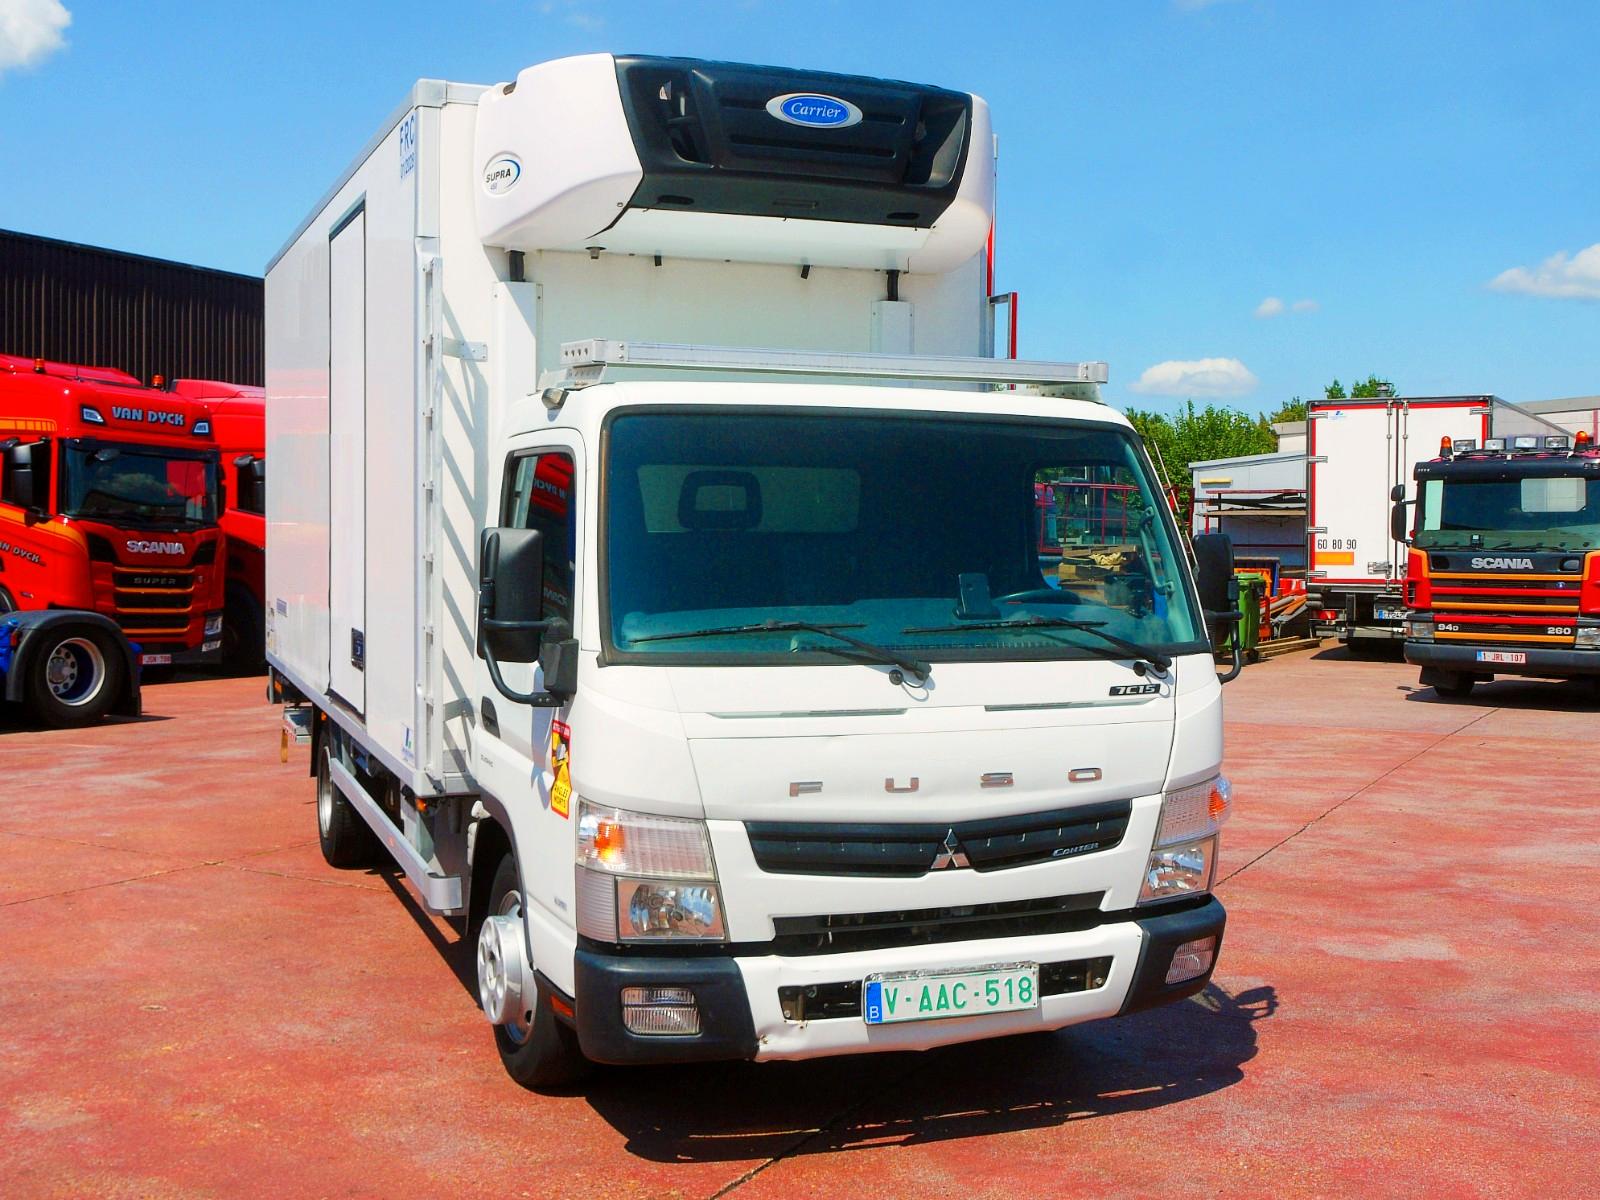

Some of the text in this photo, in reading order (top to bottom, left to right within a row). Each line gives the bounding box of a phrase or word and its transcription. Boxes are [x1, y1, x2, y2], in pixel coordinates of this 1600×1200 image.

[791, 102, 841, 118] Carrier
[400, 114, 415, 157] FRC
[486, 168, 511, 183] SUPRA
[112, 406, 185, 426] VAN DYCK
[126, 540, 185, 555] SCANIA
[1317, 539, 1357, 550] 60 80 90
[12, 546, 40, 563] DYCK
[1471, 557, 1534, 570] SCANIA
[133, 577, 177, 585] SUPER
[1547, 626, 1572, 635] 260
[1115, 684, 1156, 695] 7C15
[789, 767, 1103, 797] FUSO
[884, 976, 1033, 1015] V-AAC-518
[869, 1006, 880, 1019] B
